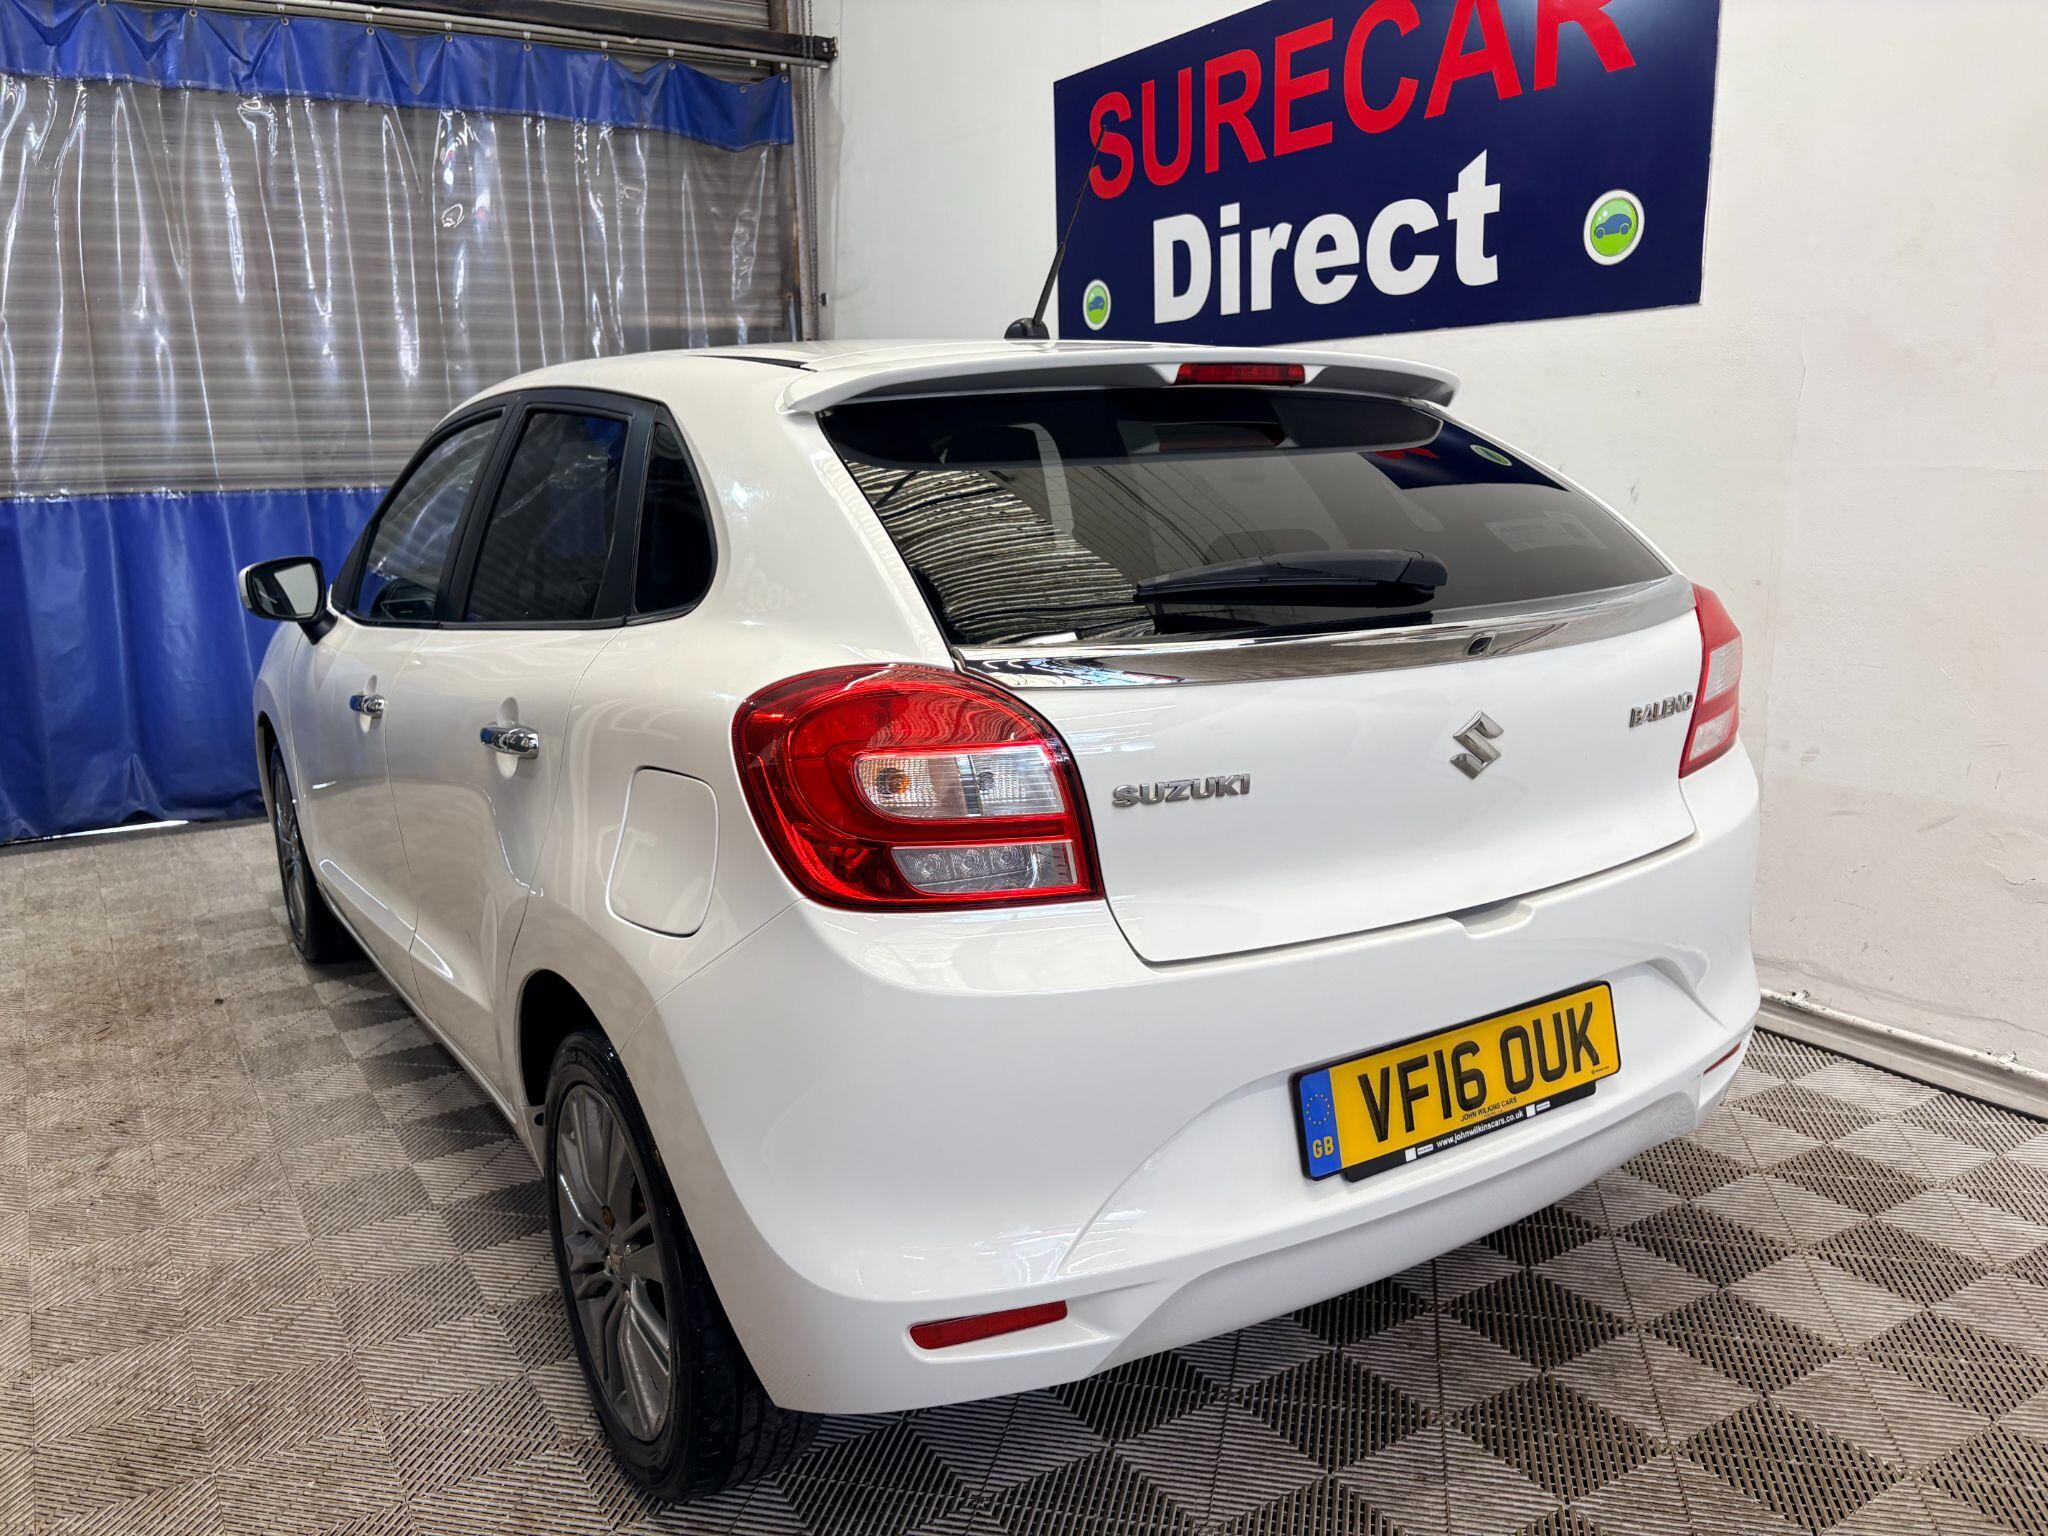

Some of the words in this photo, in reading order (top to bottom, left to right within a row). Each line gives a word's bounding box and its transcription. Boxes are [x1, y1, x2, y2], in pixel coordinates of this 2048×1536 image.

[1153, 149, 1501, 325] Direct
[1628, 691, 1694, 728] BALENO
[1112, 773, 1251, 808] SUZUKI
[1357, 1040, 1488, 1143] VF16
[1500, 1001, 1600, 1095] OUK
[1461, 1111, 1477, 1122] JOHN
[1478, 1102, 1501, 1115] WILKINS
[1501, 1096, 1517, 1107] CARS
[1312, 1135, 1334, 1159] GB
[1436, 1109, 1524, 1148] www.johnwilkinscars.co.uk
